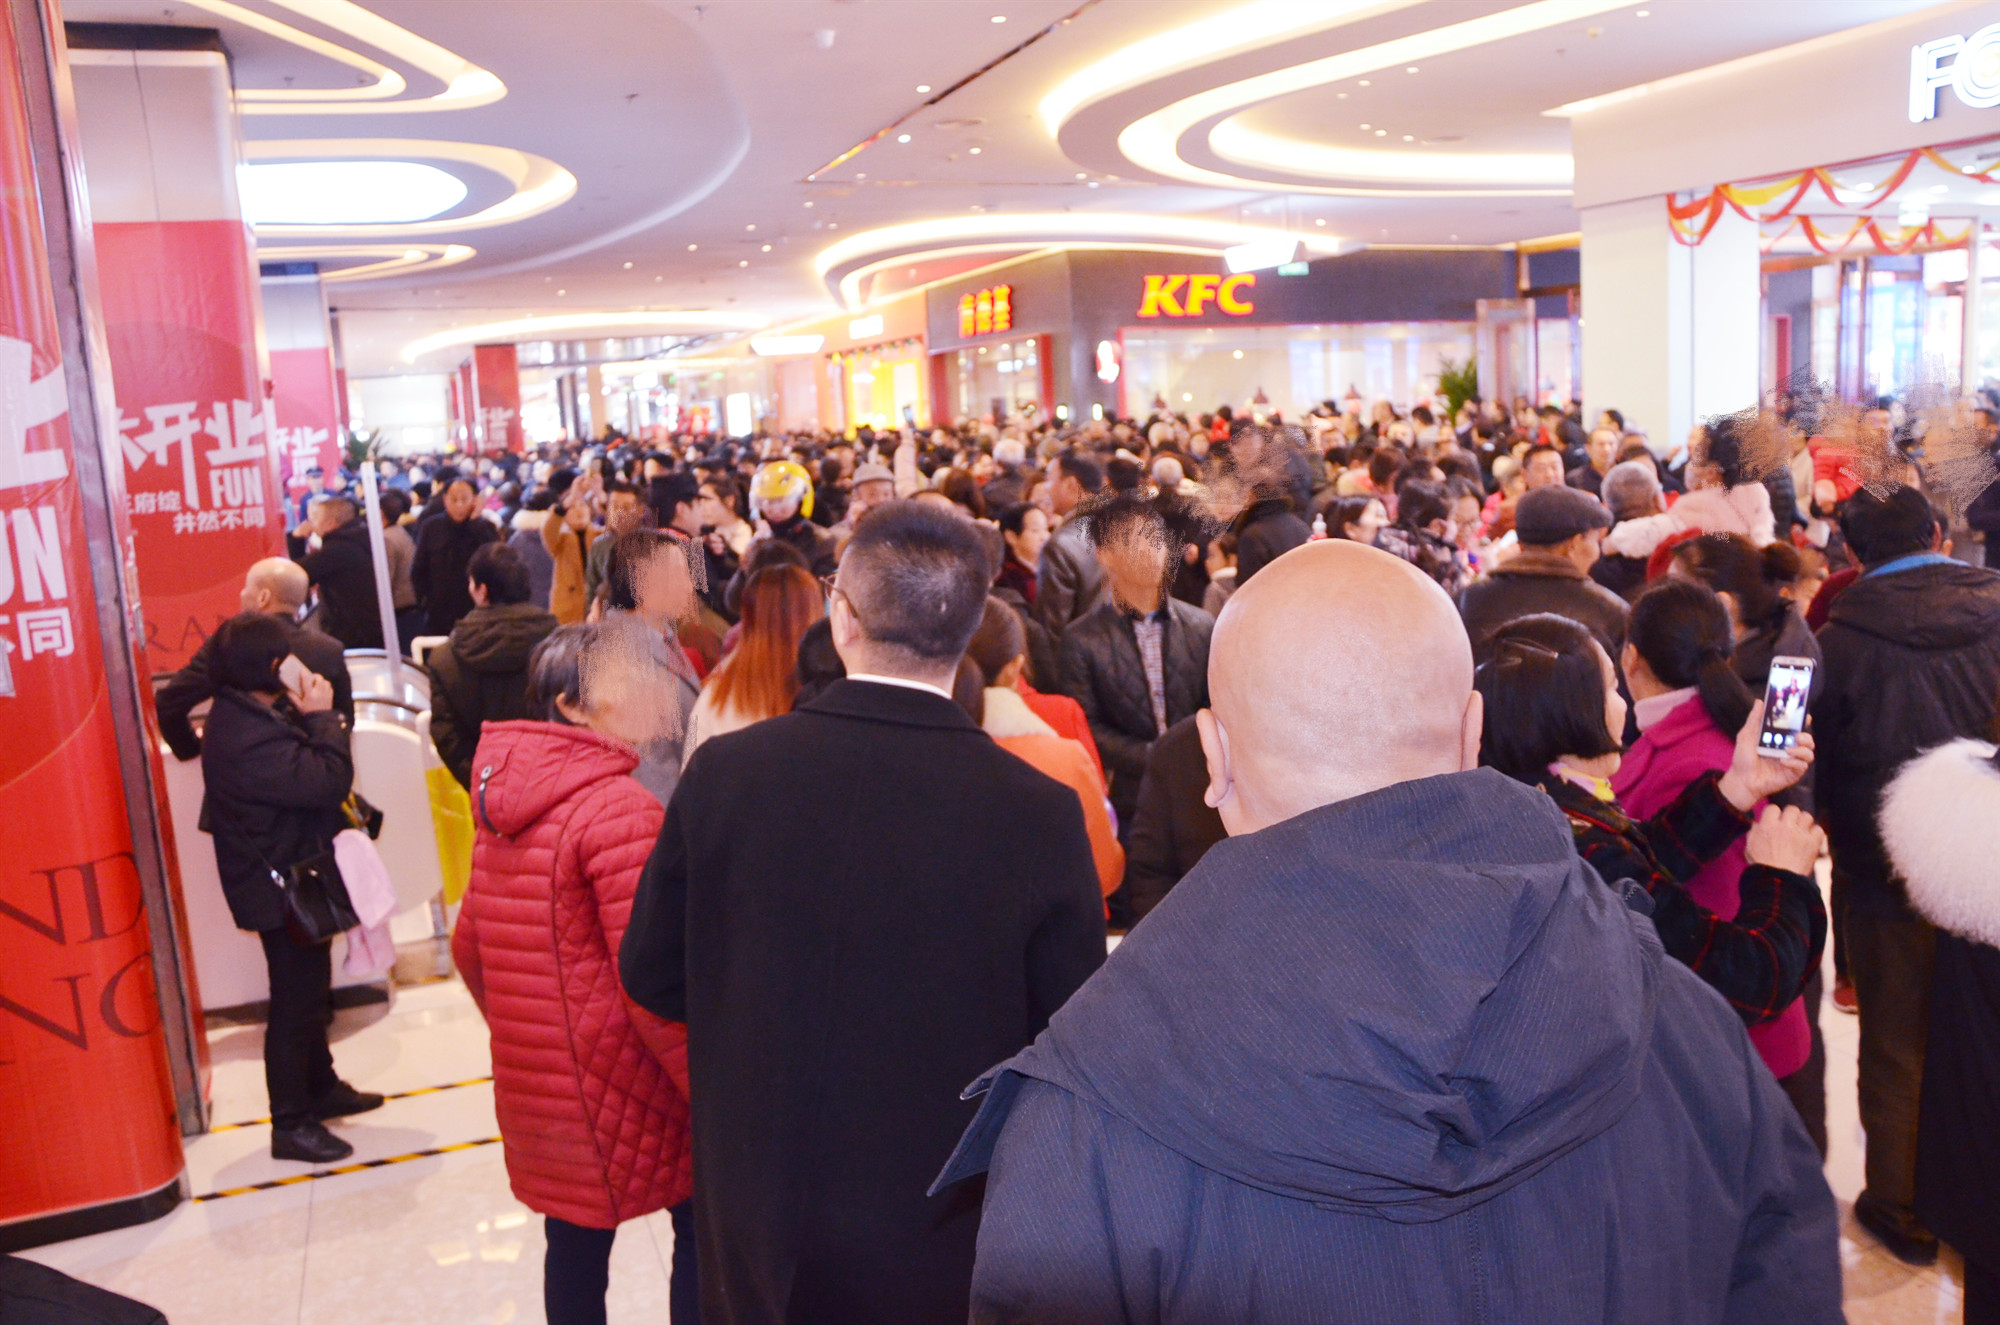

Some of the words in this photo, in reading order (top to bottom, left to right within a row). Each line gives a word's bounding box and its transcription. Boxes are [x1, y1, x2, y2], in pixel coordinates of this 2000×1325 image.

[1137, 273, 1257, 318] KFC
[209, 466, 264, 509] FUN
[173, 507, 266, 535] 井然不同
